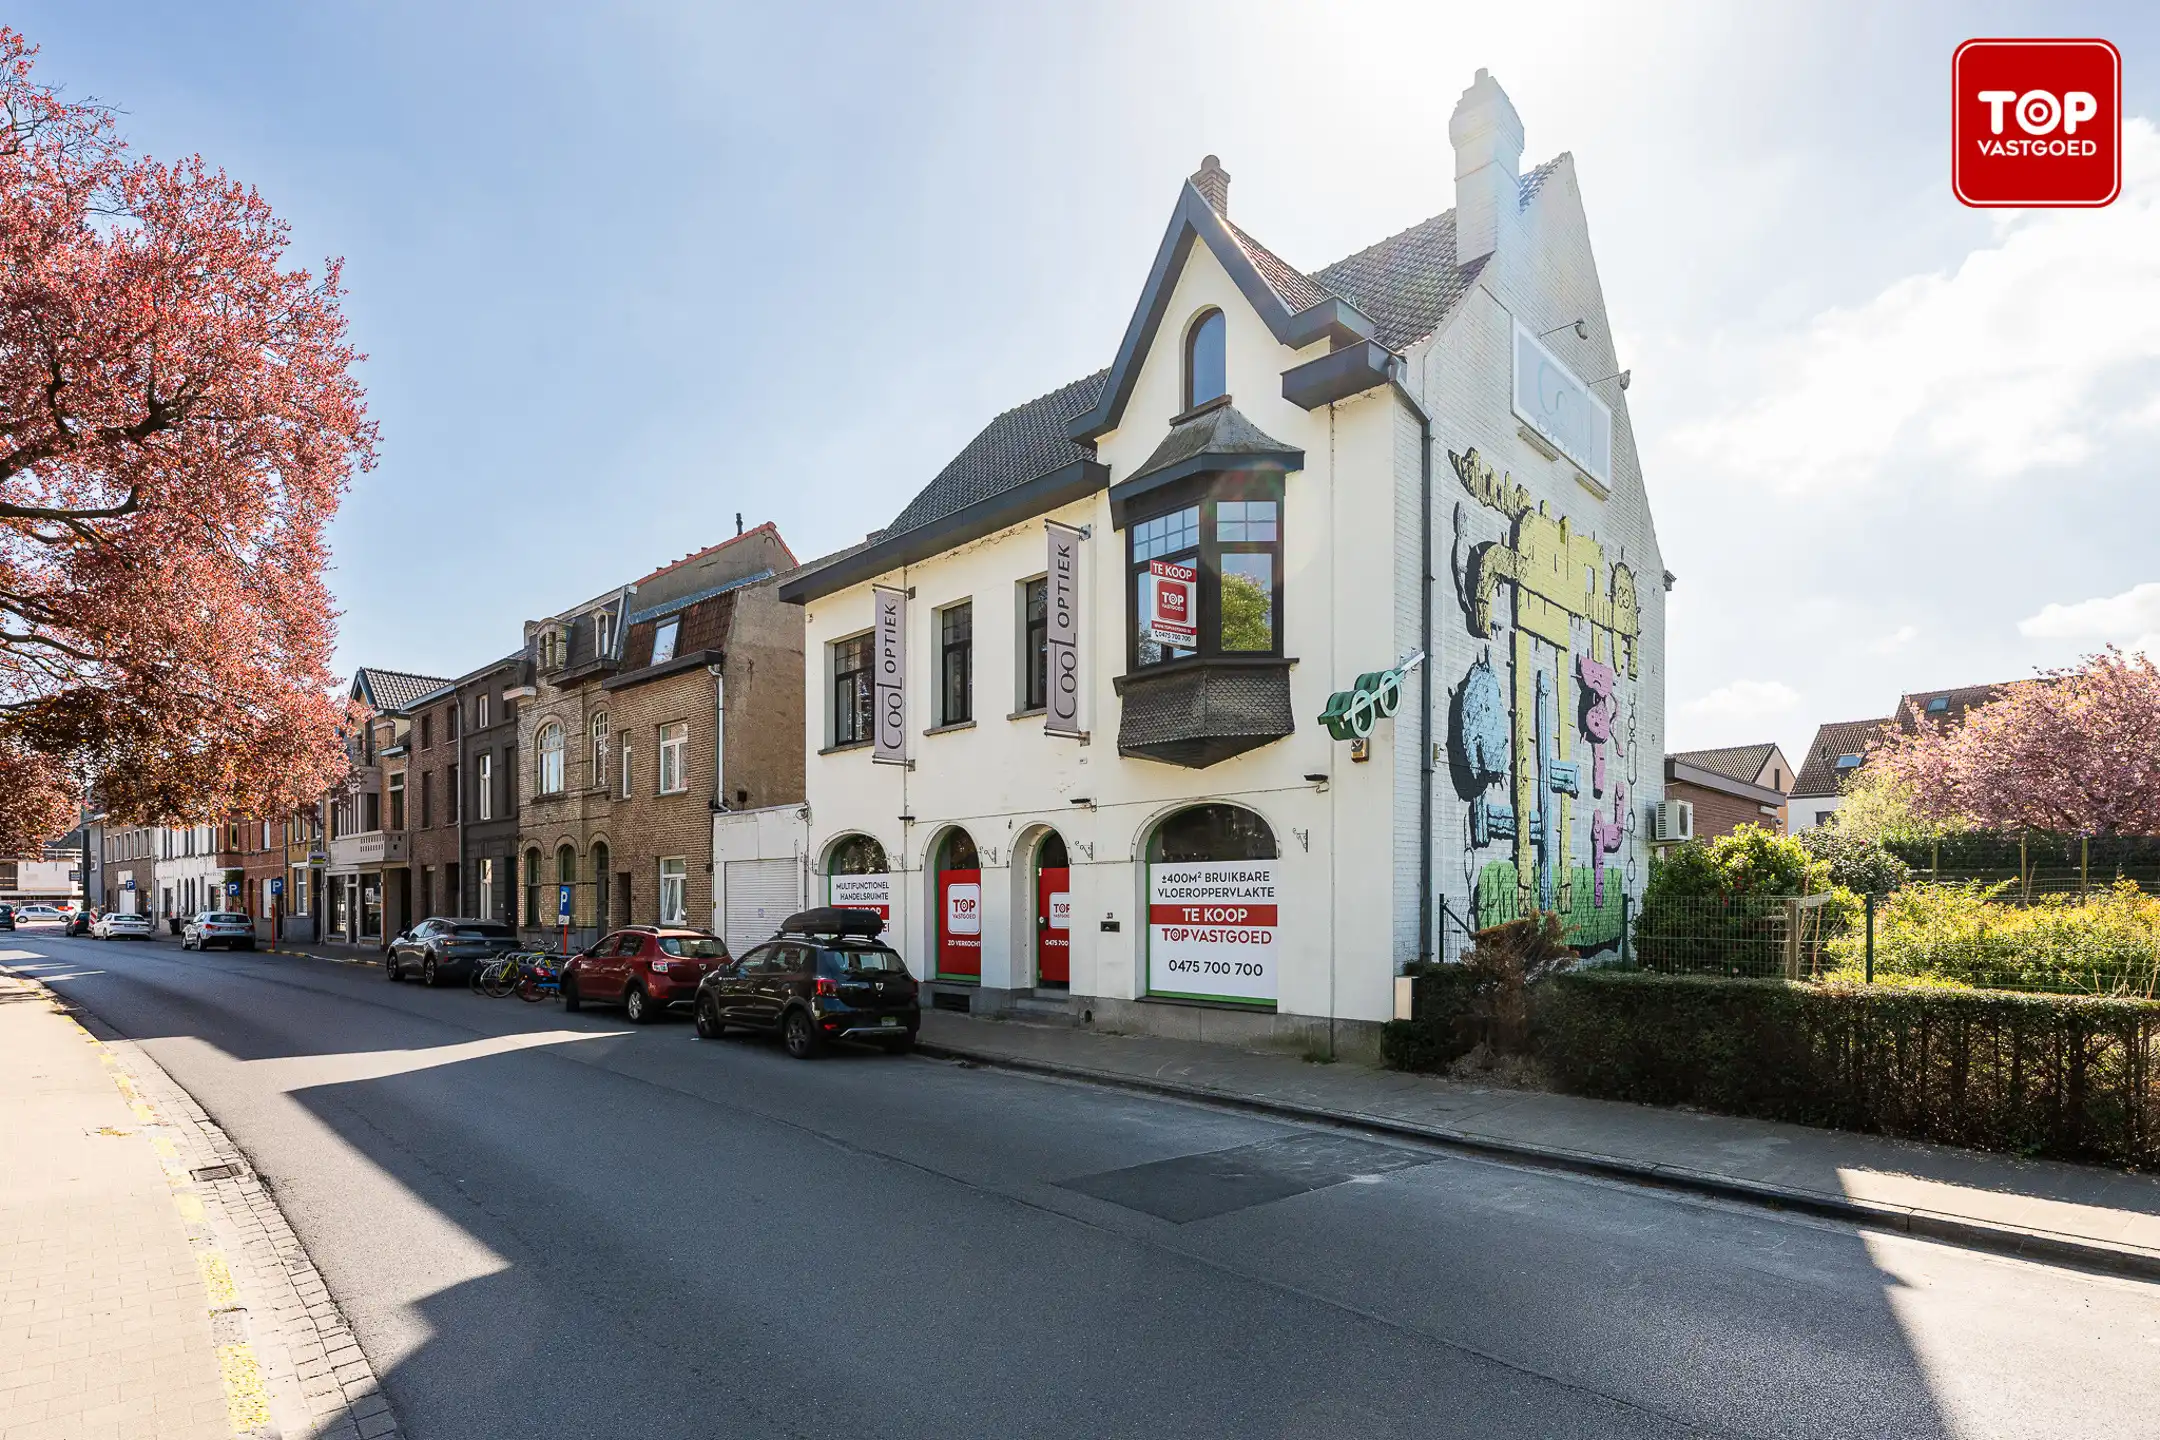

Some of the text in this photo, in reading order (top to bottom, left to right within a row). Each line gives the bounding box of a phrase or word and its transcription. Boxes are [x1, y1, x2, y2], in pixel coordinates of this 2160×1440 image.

[1152, 562, 1192, 580] TE KOOP
[1057, 543, 1070, 629] OPTIEK
[1161, 591, 1184, 606] TOP
[884, 603, 897, 674] OPTIEK
[1204, 871, 1270, 883] BRUIKBARE
[126, 882, 133, 890] P
[229, 884, 237, 895] P
[272, 881, 282, 892] P
[1157, 886, 1275, 898] VLOEROPPERVLAKTE
[561, 891, 568, 911] P
[840, 892, 889, 900] HANDELSRUIMTE
[952, 899, 976, 913] TOP
[1182, 908, 1248, 922] TE KOOP
[1190, 929, 1272, 944] VASTGOED
[1168, 960, 1263, 976] 0475 700 700
